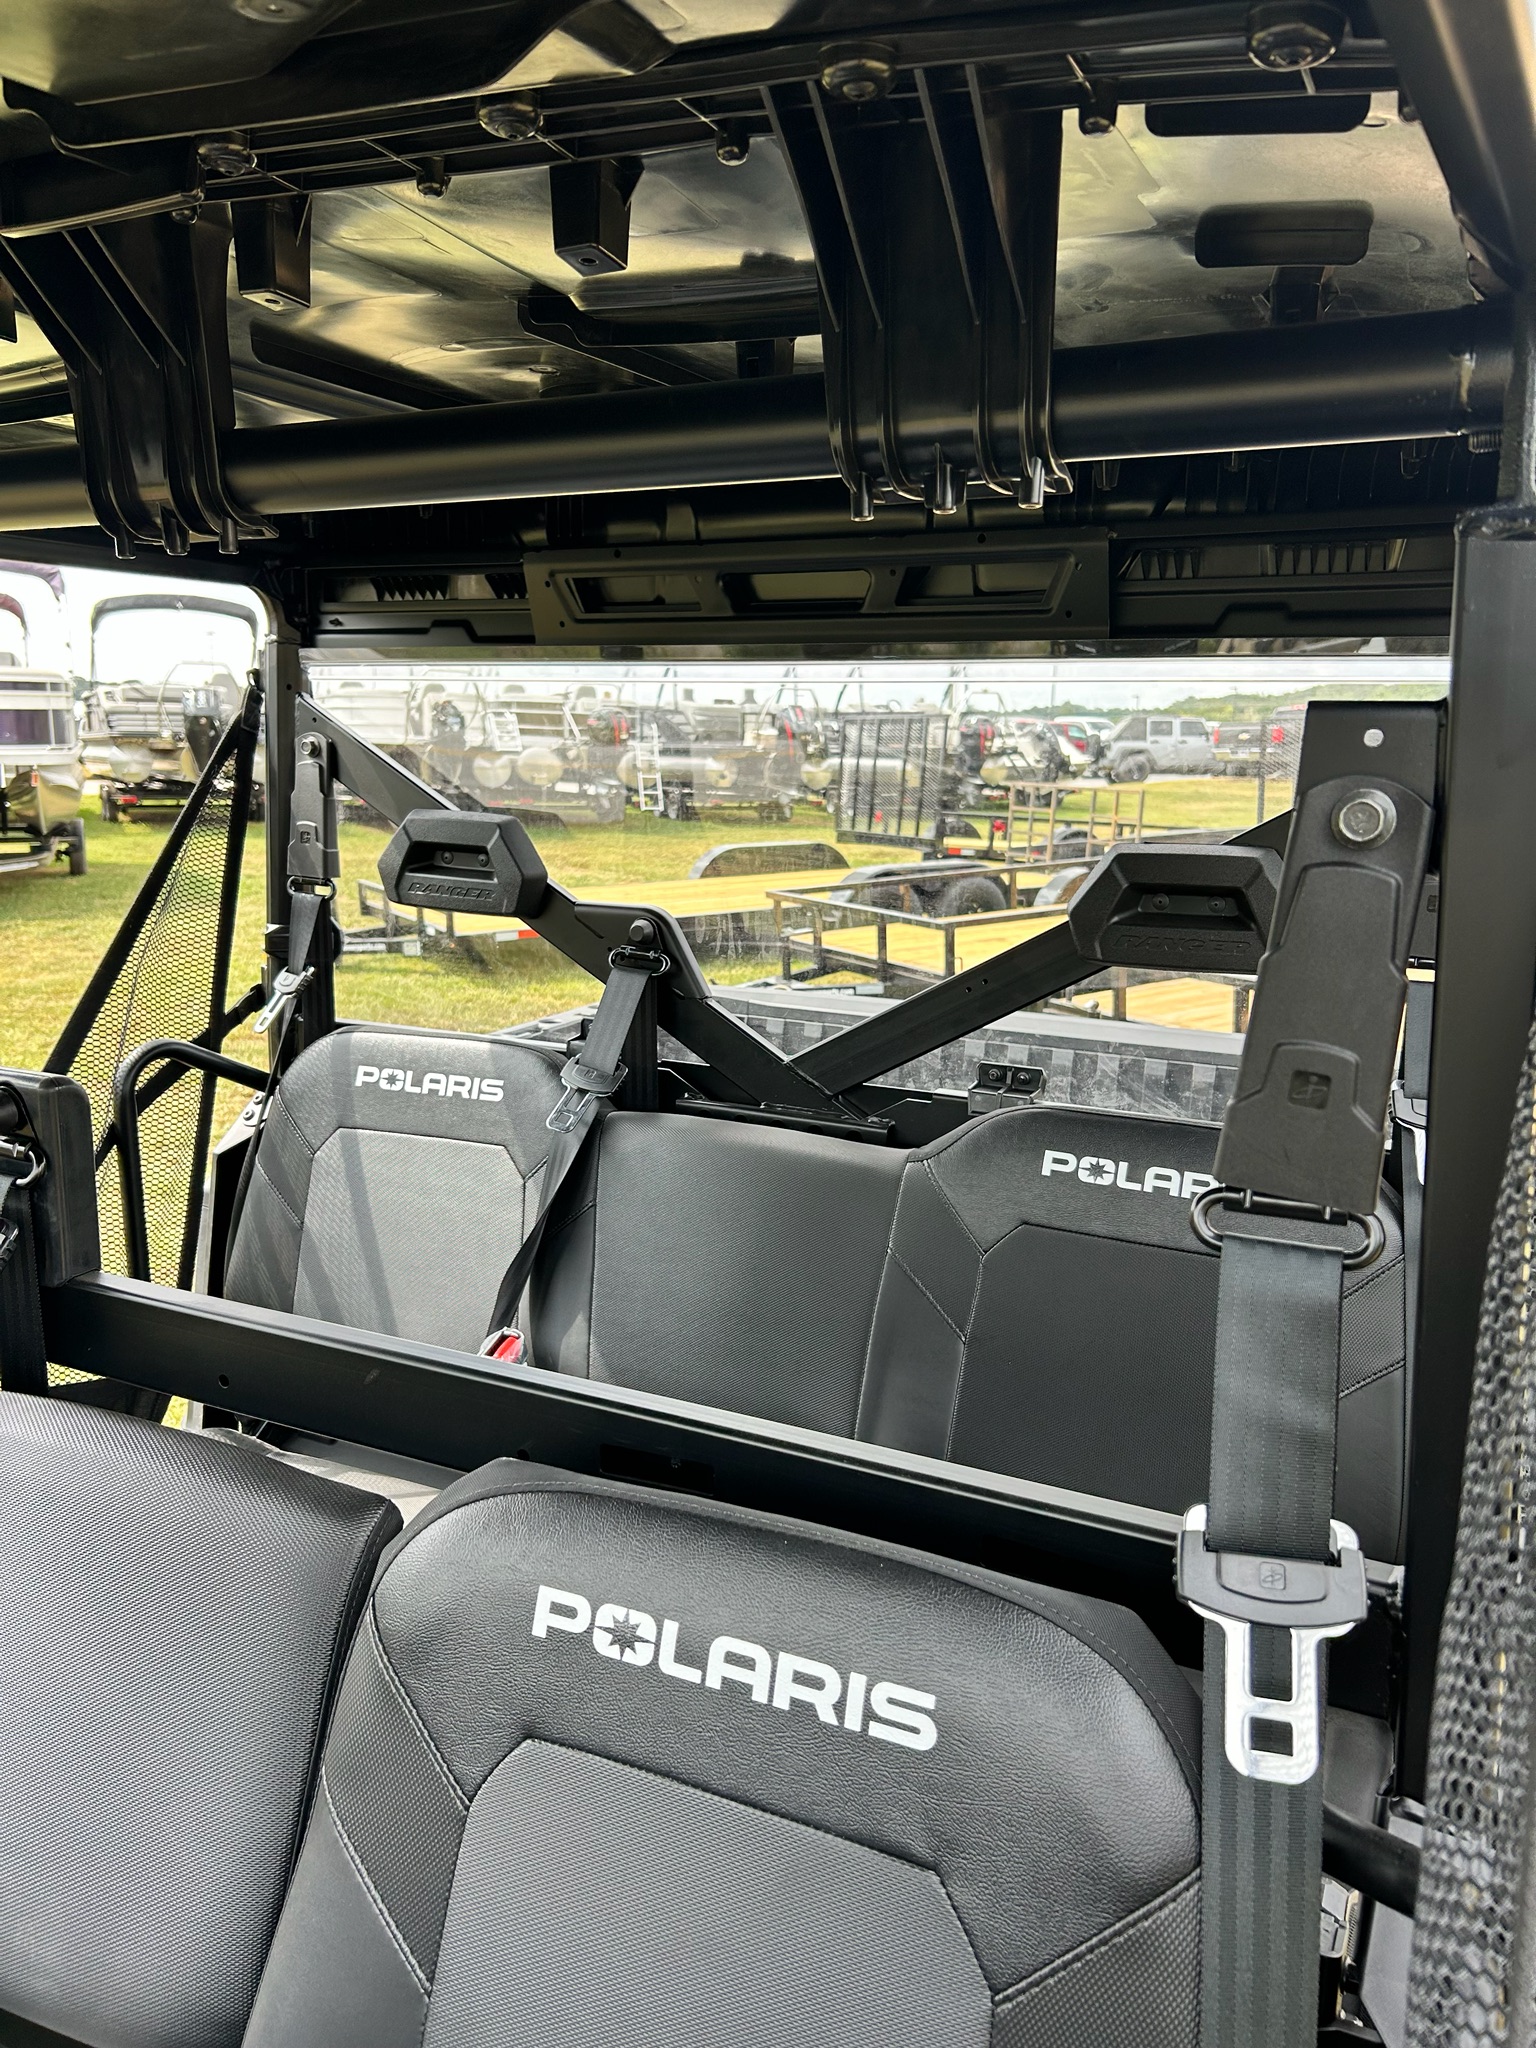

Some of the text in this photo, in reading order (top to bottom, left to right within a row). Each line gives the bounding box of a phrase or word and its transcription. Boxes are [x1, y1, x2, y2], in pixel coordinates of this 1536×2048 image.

[408, 881, 496, 901] RANGER
[1112, 933, 1251, 956] RANGER
[355, 1065, 504, 1102] POLARIS
[1041, 1149, 1219, 1199] POLAR
[531, 1585, 938, 1751] POLARIS
